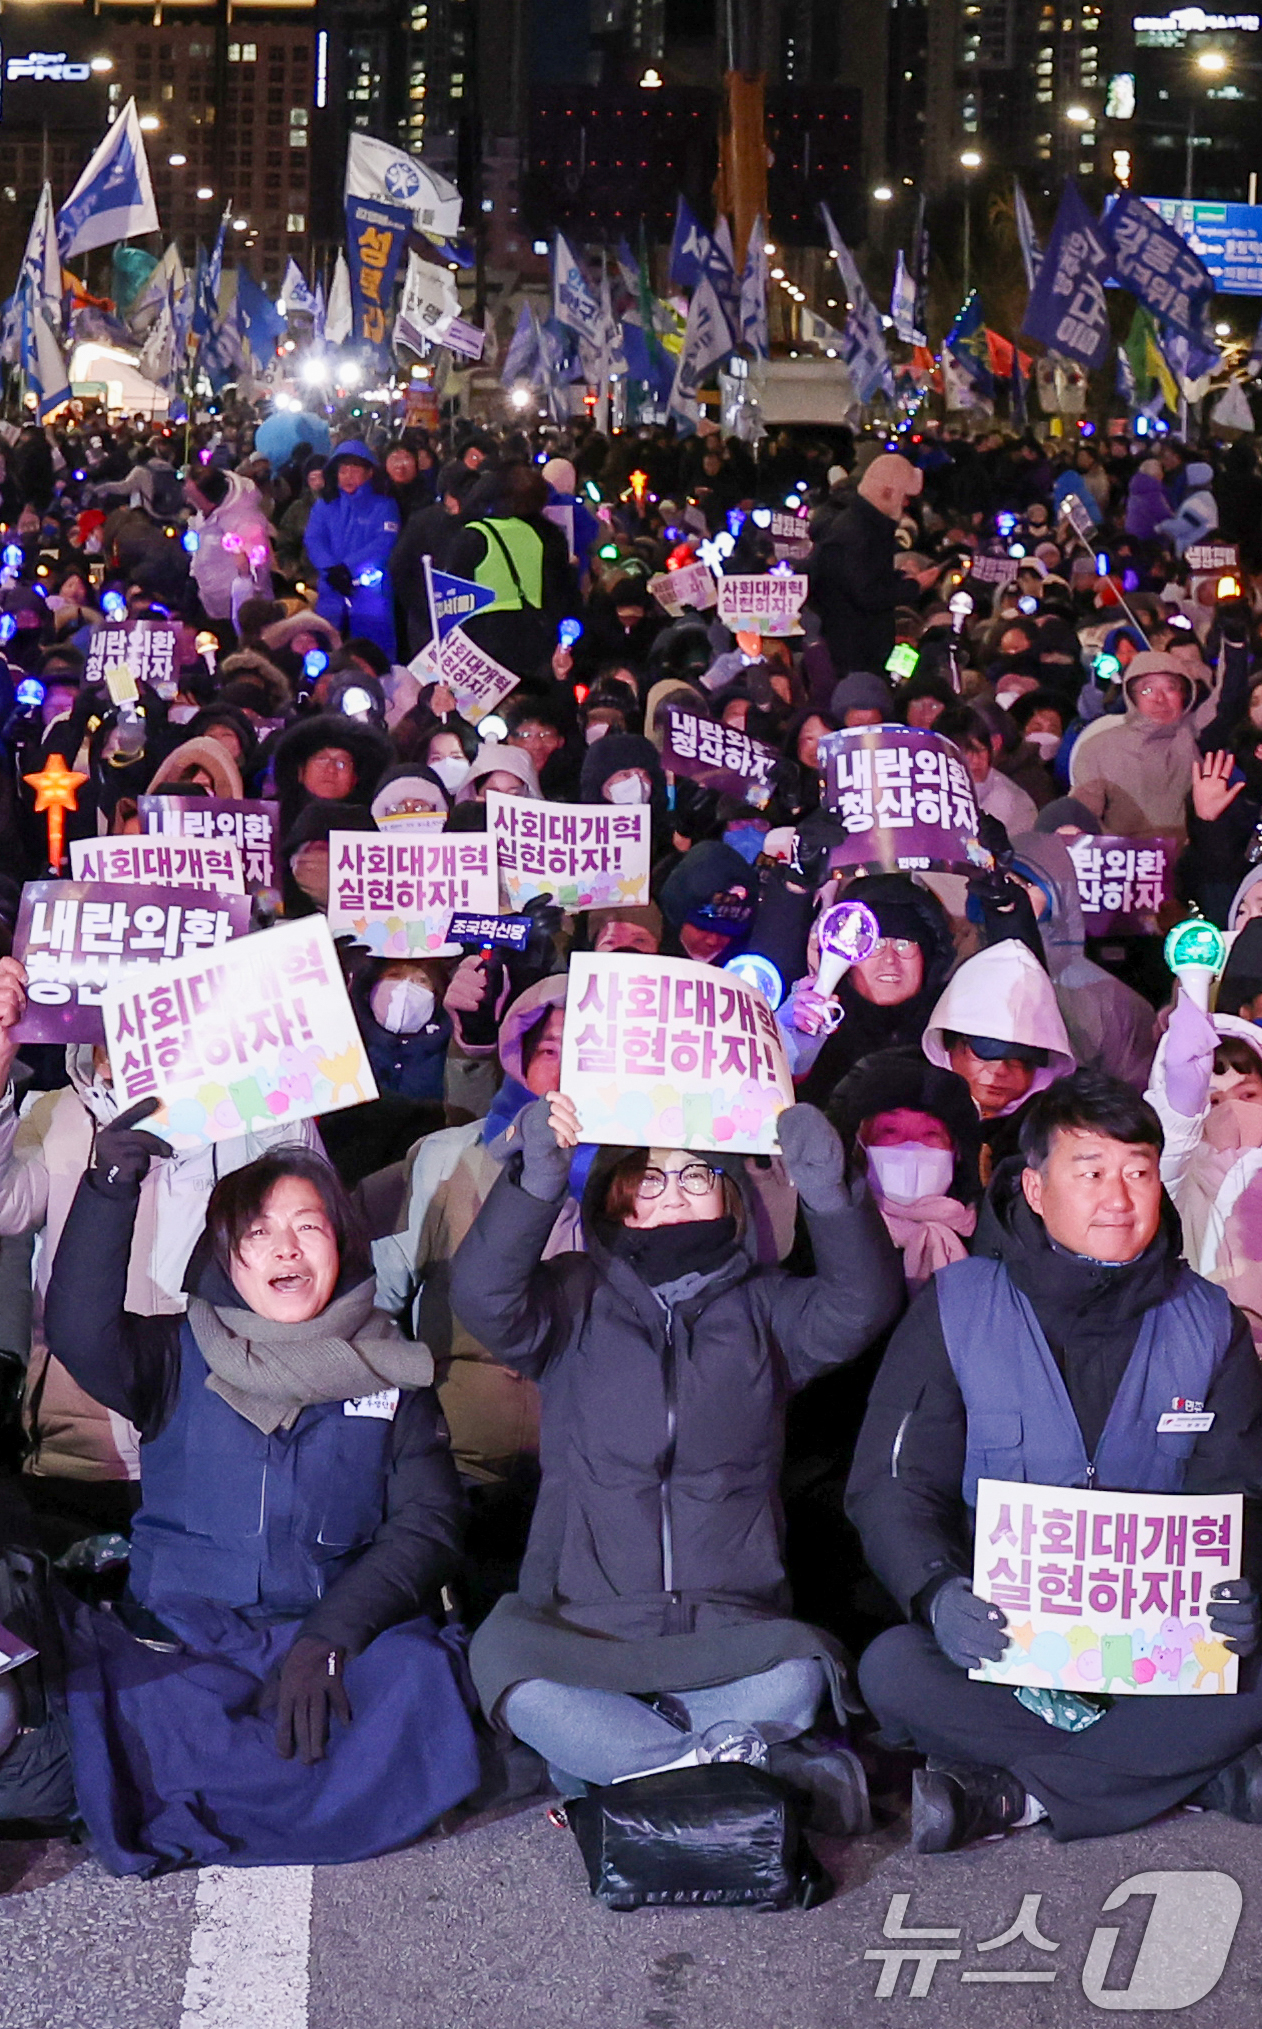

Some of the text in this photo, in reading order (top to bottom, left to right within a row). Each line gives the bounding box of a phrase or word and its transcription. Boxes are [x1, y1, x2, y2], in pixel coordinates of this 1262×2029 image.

[723, 580, 804, 597] 사회대개혁
[90, 630, 176, 656] 내란외환
[837, 747, 973, 800] 내란외환
[148, 810, 273, 851] 내란외환
[494, 805, 641, 846] 사회대개혁
[838, 787, 979, 836] 청산하자
[80, 847, 235, 881] 사회대개혁
[337, 844, 488, 877] 사회대개혁
[497, 837, 621, 876] 실현하자!
[897, 857, 930, 869] 민주당
[1070, 848, 1166, 881] 란외환
[337, 879, 469, 911] 실현하자!
[30, 900, 233, 957] 내란외환
[452, 919, 526, 940] 조국혁신당
[577, 972, 783, 1053] 사회대개혁
[121, 997, 314, 1099] 실현하자!
[575, 1024, 776, 1082] 실현하자!
[988, 1504, 1231, 1566] 사회대개혁
[987, 1557, 1203, 1619] 실현하자!
